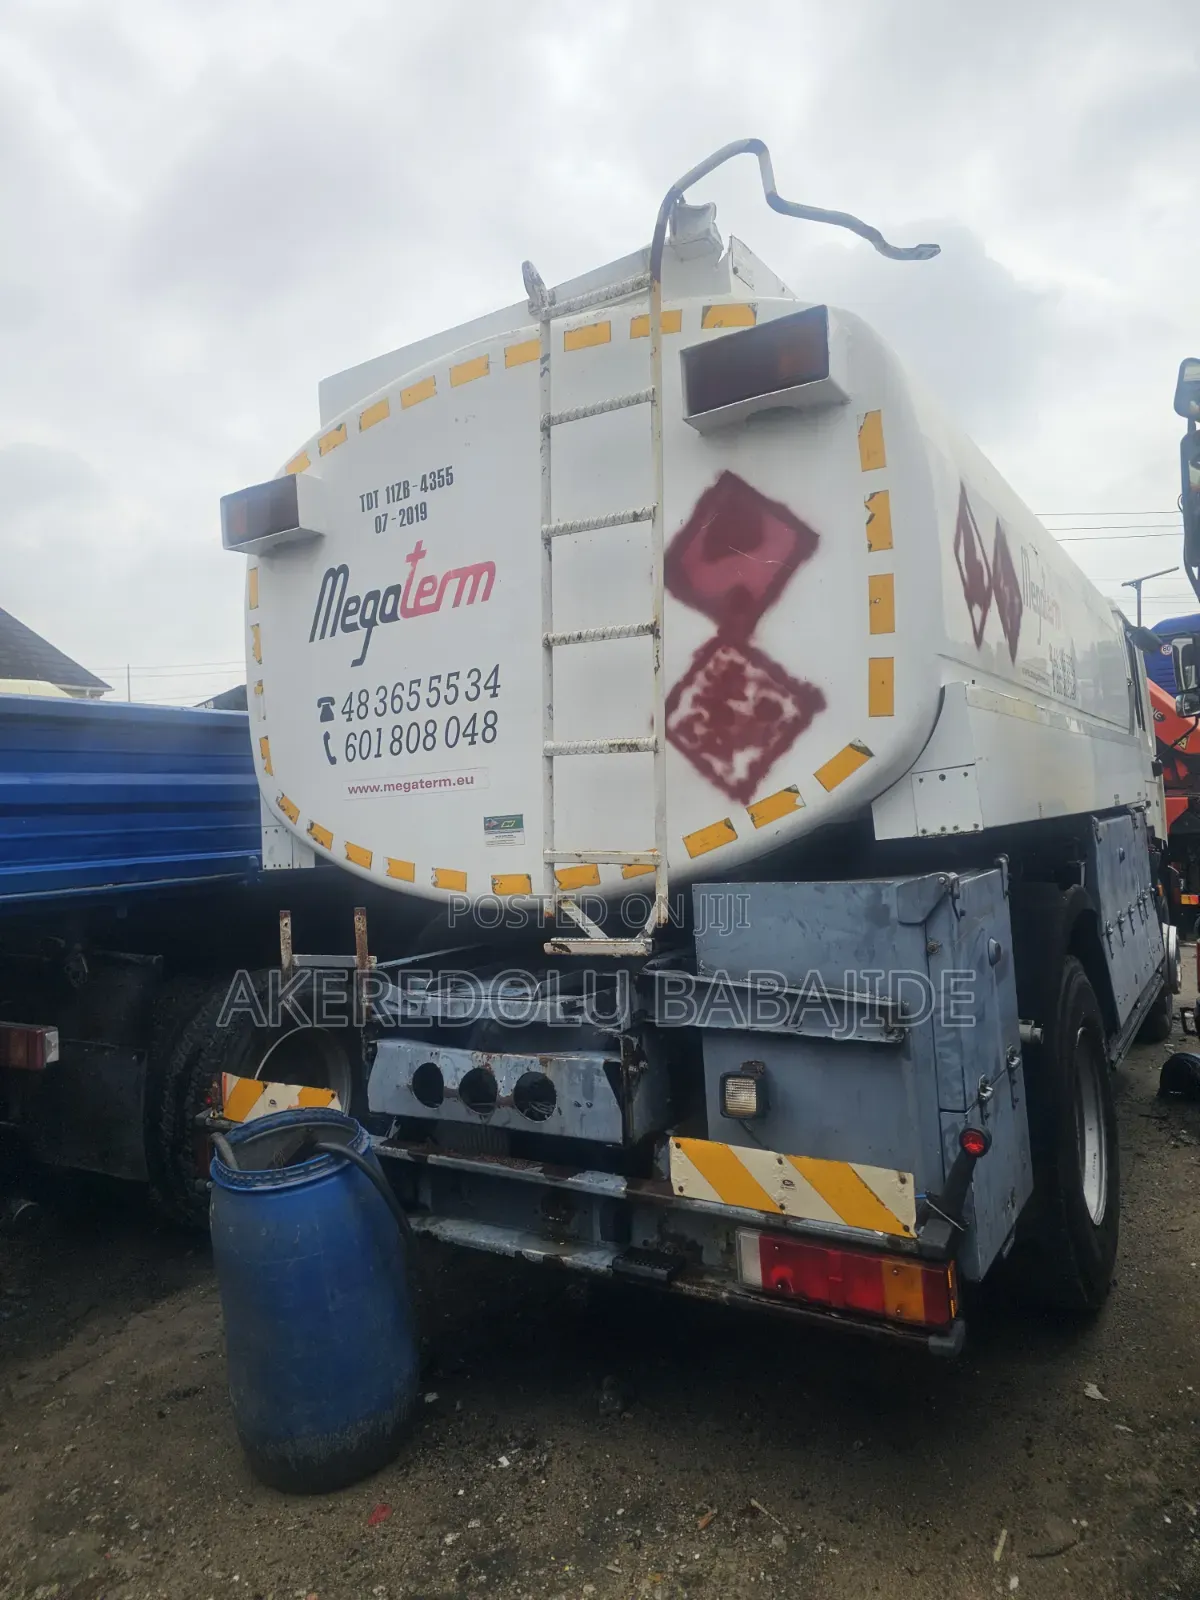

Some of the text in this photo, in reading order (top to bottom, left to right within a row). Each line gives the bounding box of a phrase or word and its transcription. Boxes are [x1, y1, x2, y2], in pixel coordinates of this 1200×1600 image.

[359, 489, 380, 513] TDT
[308, 540, 496, 668] Megaterm
[347, 774, 475, 795] www.megaterm.eu
